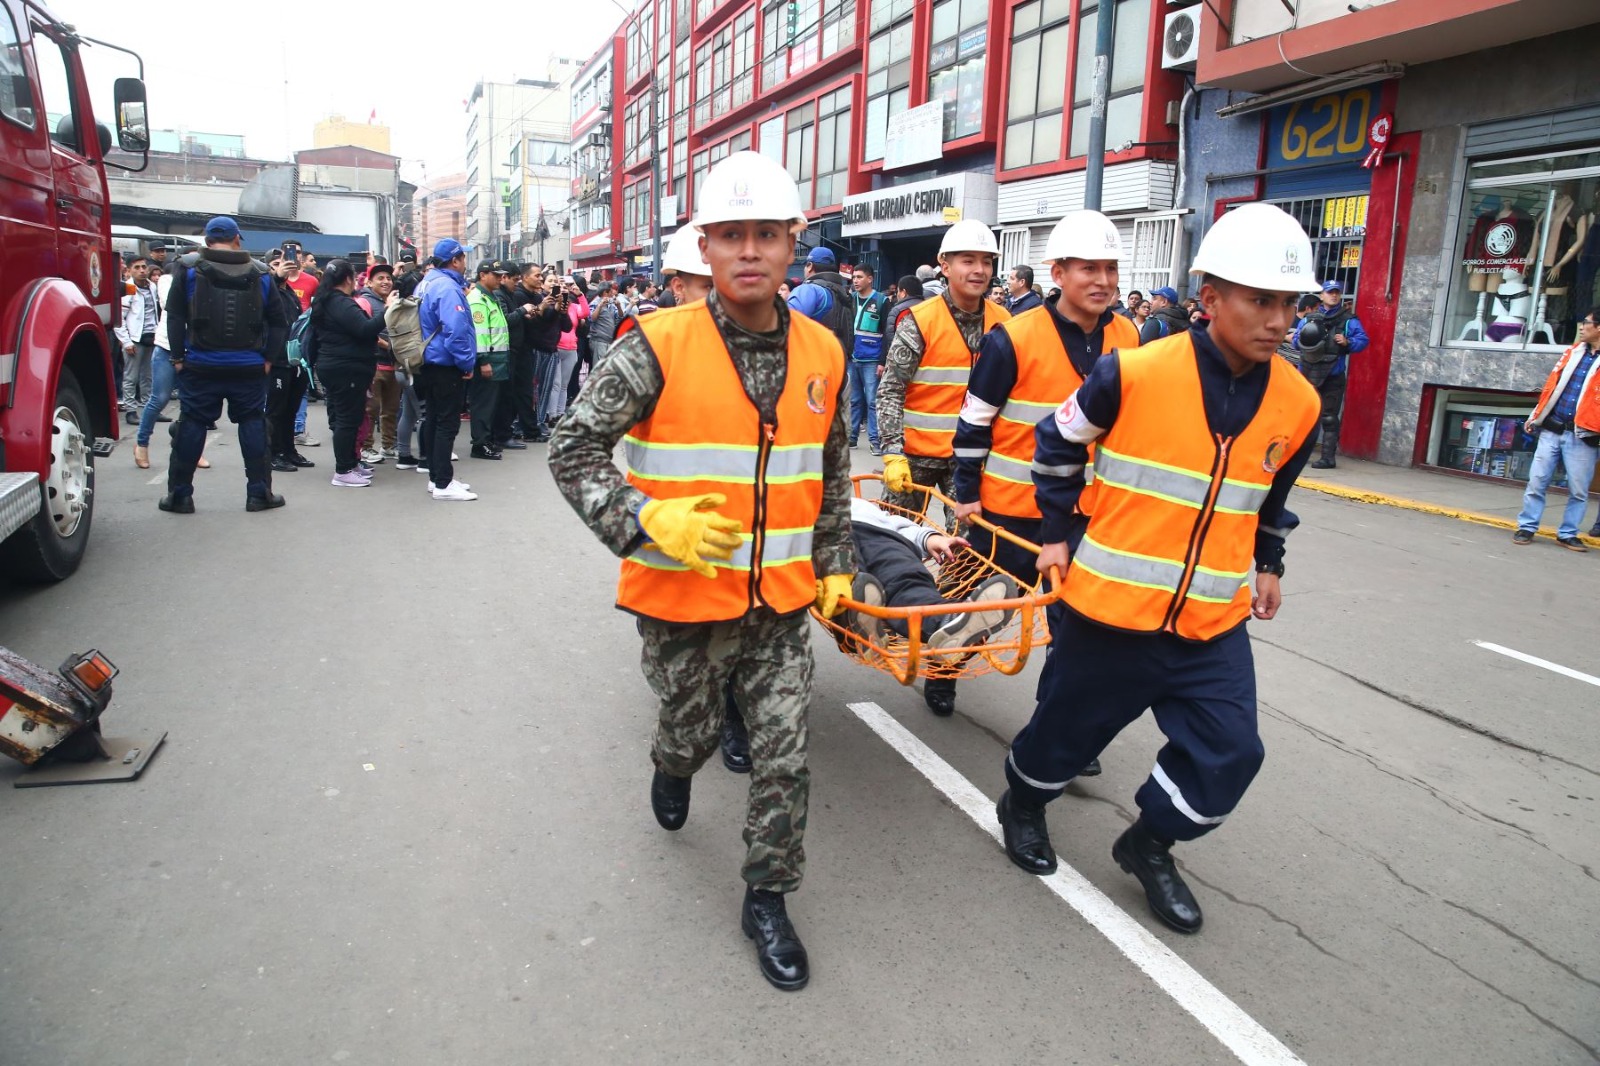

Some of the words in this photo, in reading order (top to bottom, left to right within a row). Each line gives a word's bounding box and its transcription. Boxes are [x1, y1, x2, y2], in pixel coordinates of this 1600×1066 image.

[1281, 89, 1371, 161] 620
[729, 199, 753, 207] CIRD
[842, 201, 870, 226] GALERIA
[873, 193, 912, 220] MERCADO
[914, 187, 954, 215] CENTRAL
[1280, 265, 1301, 274] CIRD
